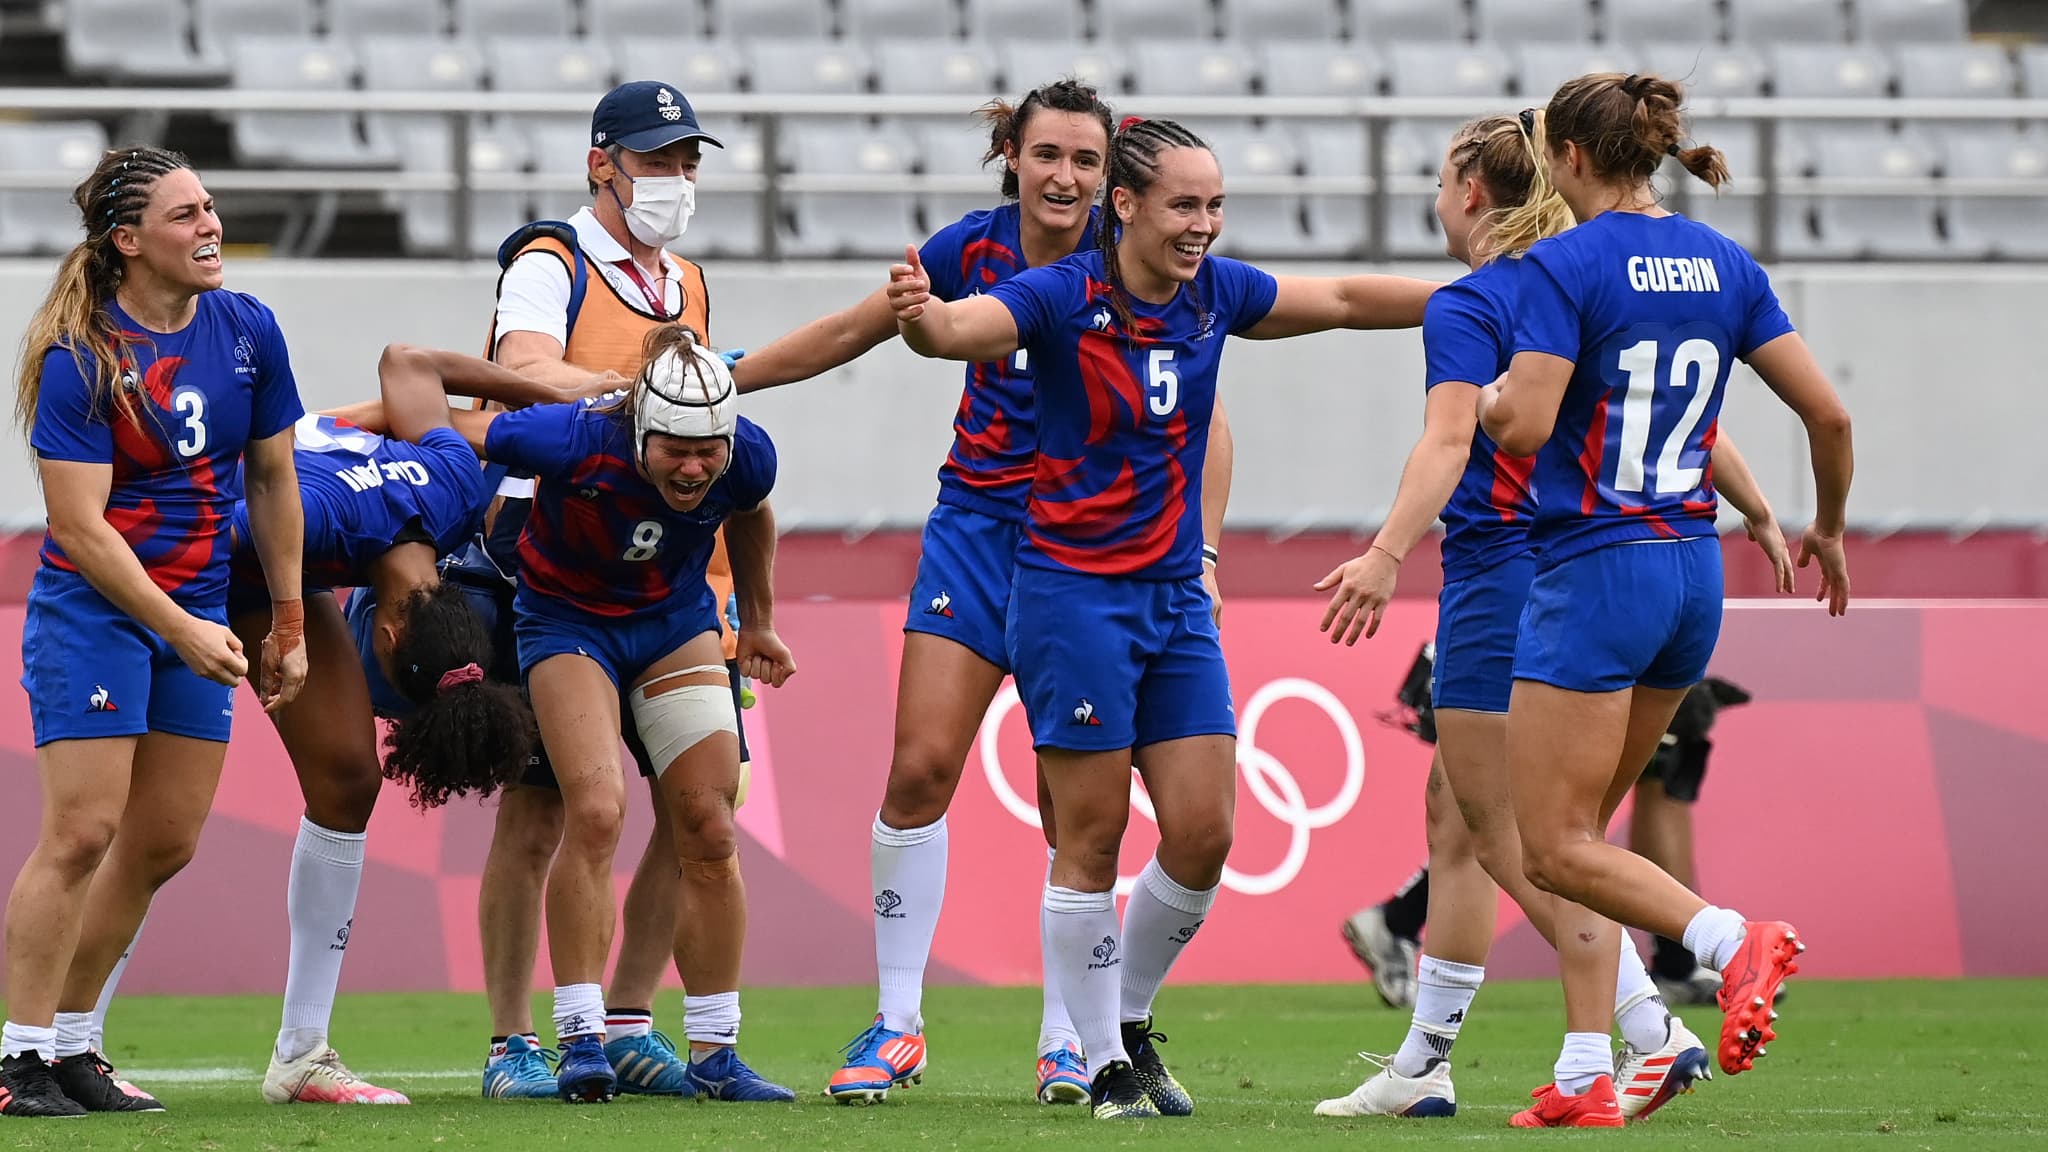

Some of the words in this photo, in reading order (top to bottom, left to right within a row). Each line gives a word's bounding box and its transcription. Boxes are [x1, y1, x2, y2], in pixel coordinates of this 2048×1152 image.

[1627, 255, 1720, 292] GUERIN
[1148, 349, 1178, 416] 5
[175, 391, 206, 457] 3
[1614, 338, 1720, 493] 12
[622, 520, 663, 561] 8
[1087, 958, 1121, 970] FRANCE
